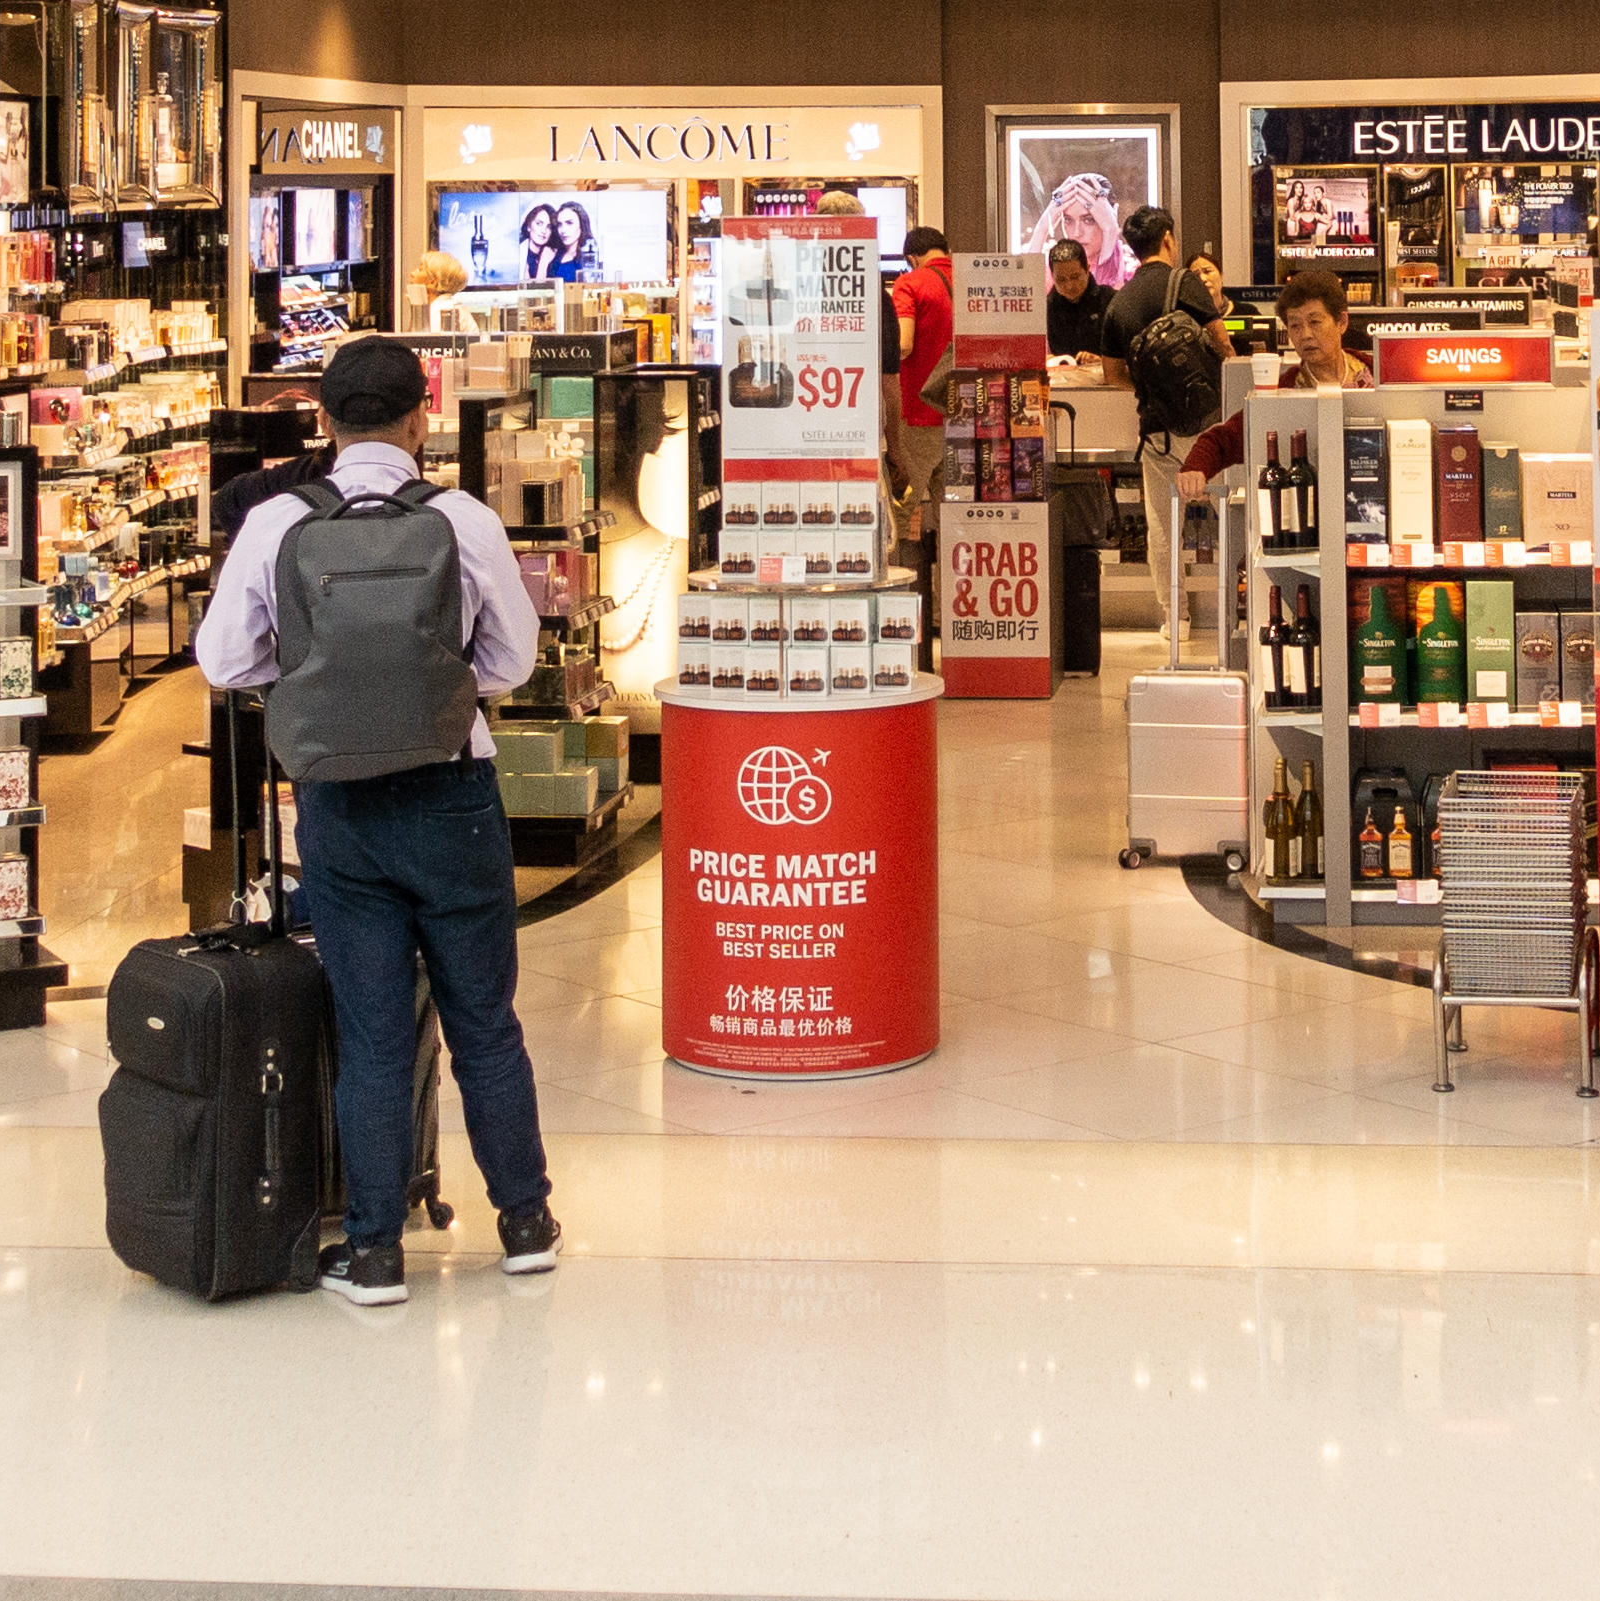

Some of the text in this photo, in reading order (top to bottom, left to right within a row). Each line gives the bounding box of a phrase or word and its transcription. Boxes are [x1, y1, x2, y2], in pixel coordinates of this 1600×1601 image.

[301, 120, 363, 159] CHANEL
[549, 116, 790, 165] LANCÔME
[795, 245, 866, 273] PRICE
[1343, 247, 1375, 257] COLOR
[795, 275, 866, 299] MATCH
[967, 286, 986, 297] BUY
[795, 299, 865, 314] GUARANTEE
[967, 298, 1034, 313] GET 1 FREE
[1470, 299, 1525, 312] VITAMINS
[1366, 321, 1451, 336] CHOCOLATES
[1426, 347, 1502, 365] SAVINGS
[798, 363, 865, 412] $97
[976, 377, 984, 414] GODIVA
[1010, 376, 1018, 414] GODIVA
[951, 542, 1039, 577] GRAB
[952, 578, 1039, 617] & GO
[951, 620, 1039, 641] 随购即行
[689, 848, 877, 879] PRICE MATCH
[696, 878, 868, 907] GUARANTEE
[715, 921, 845, 940] BEST PRICE ON
[723, 941, 836, 959] BEST SELLER
[724, 984, 834, 1013] 价格保证
[709, 1014, 853, 1037] 畅销商品最优价格
